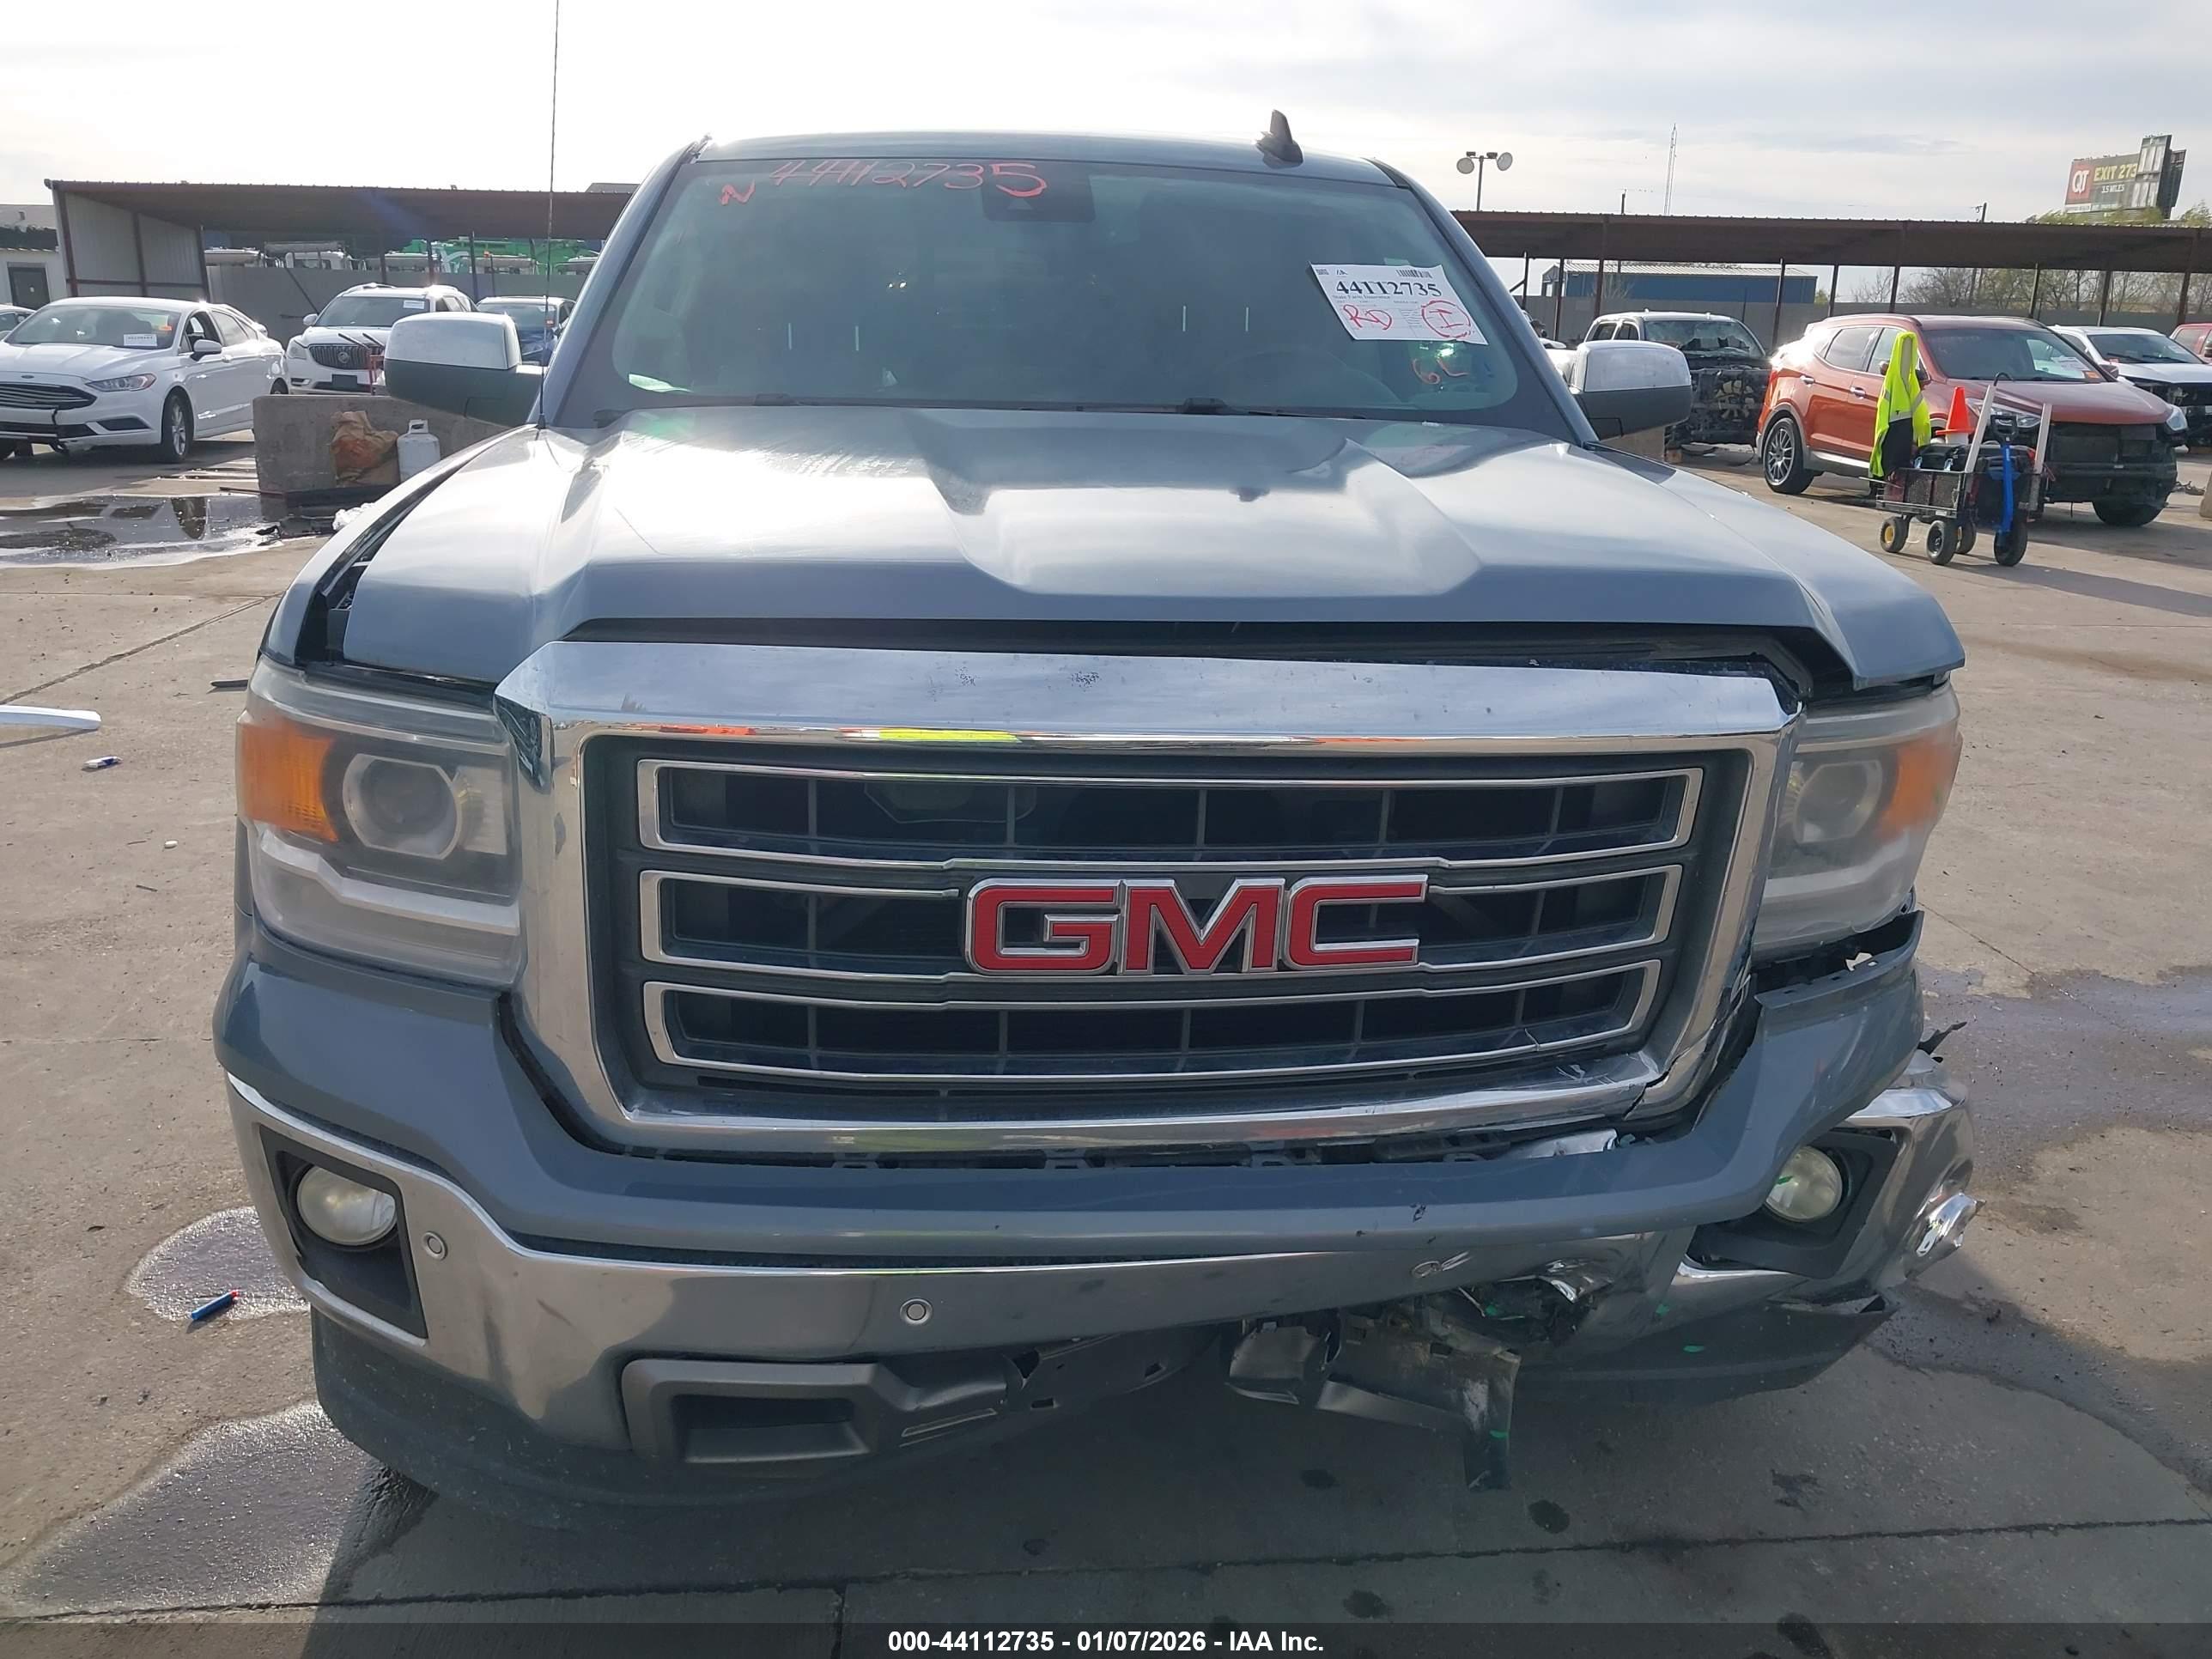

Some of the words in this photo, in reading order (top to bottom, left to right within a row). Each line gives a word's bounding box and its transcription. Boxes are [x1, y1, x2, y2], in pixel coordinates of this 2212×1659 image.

[769, 159, 1048, 198] 44112735
[2072, 170, 2089, 193] QT
[2094, 165, 2118, 181] EXIT
[2118, 163, 2139, 179] 273
[1336, 281, 1443, 297] 44112735
[965, 874, 1428, 976] GMC
